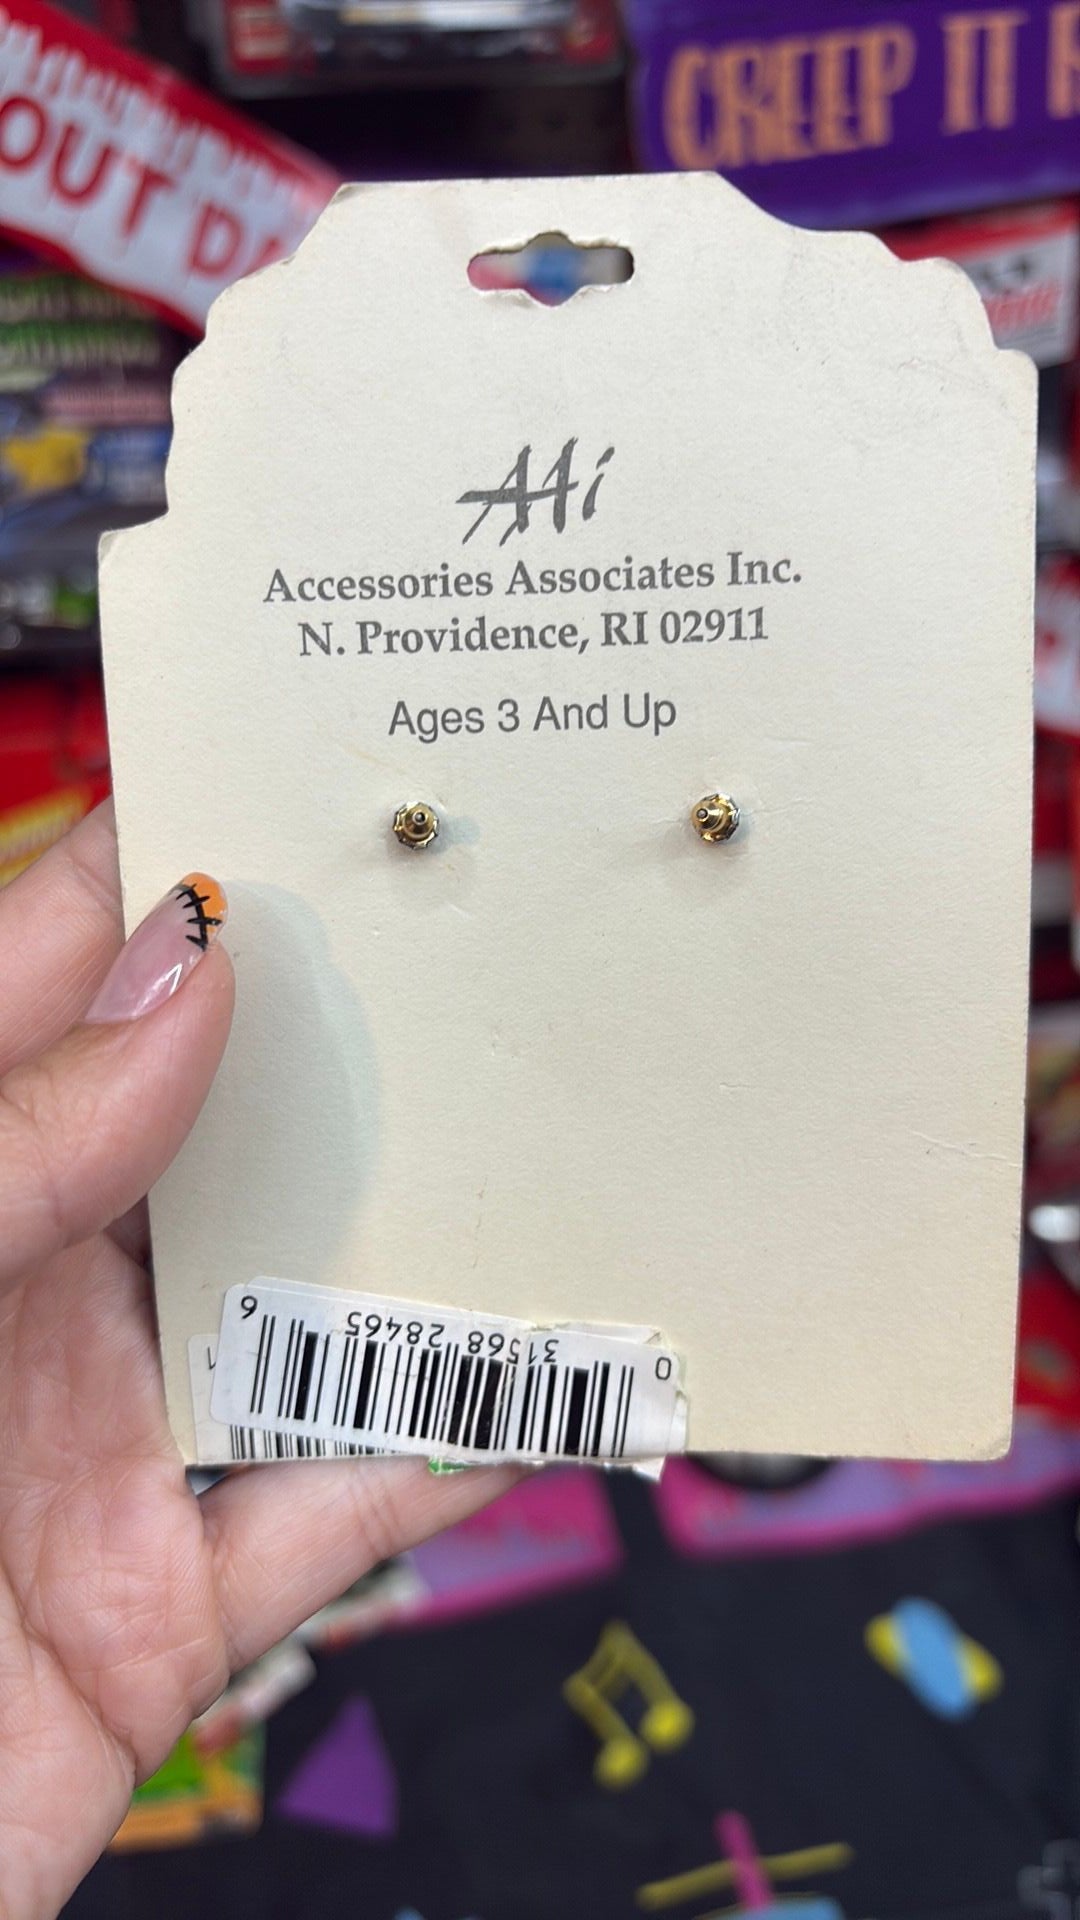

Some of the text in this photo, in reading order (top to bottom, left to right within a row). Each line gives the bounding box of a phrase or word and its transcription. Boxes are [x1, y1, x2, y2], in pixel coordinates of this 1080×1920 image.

[662, 22, 917, 170] CREEP
[942, 10, 1028, 135] IT
[0, 94, 177, 240] OUT
[263, 551, 802, 603] Accessories Associates Inc.
[298, 606, 769, 657] N. Providence, RI 02911
[388, 692, 677, 744] Ages 3 And Up
[240, 1295, 671, 1380] 0 31568 28465 6
